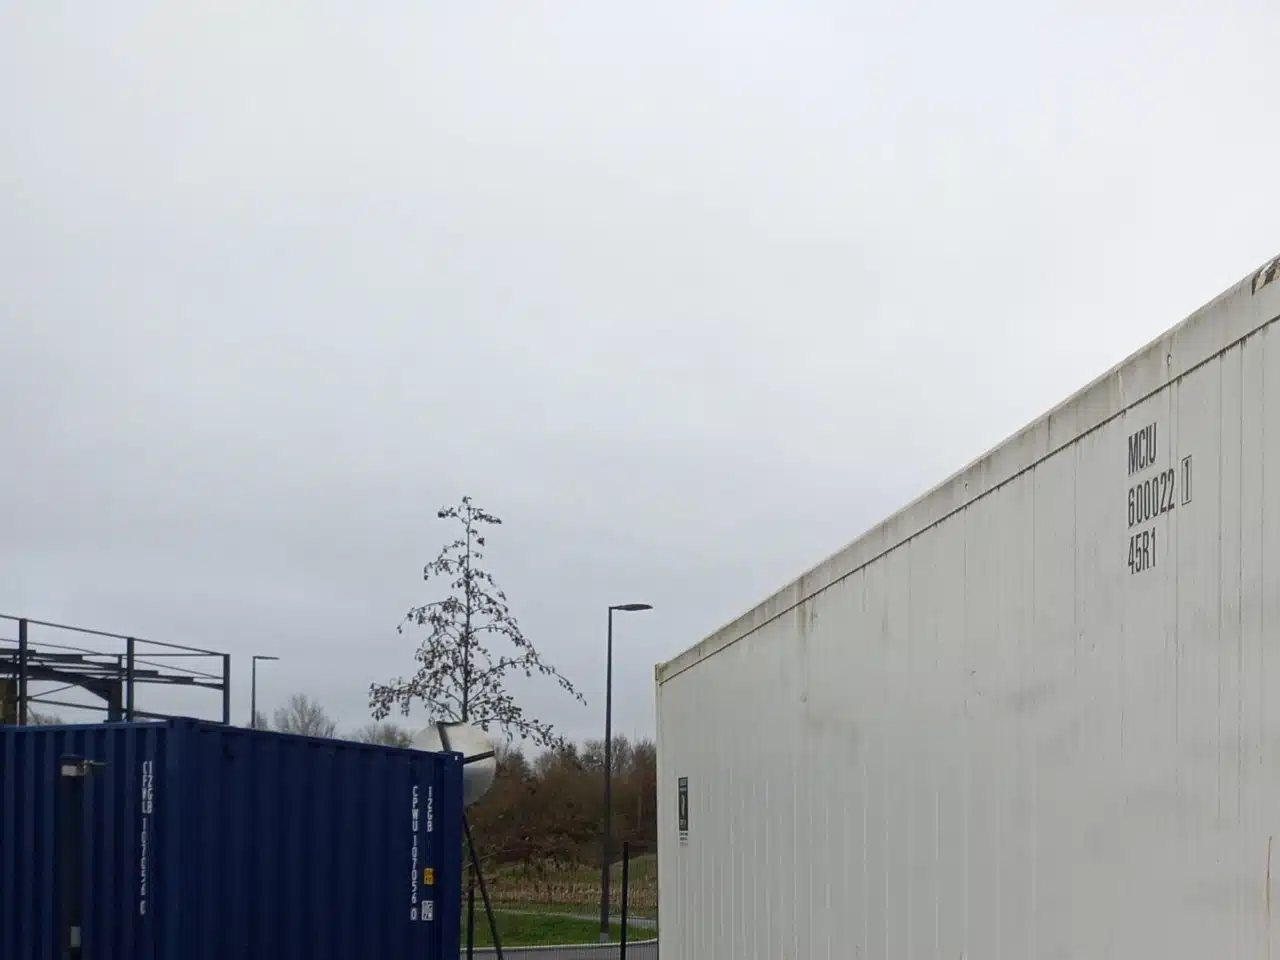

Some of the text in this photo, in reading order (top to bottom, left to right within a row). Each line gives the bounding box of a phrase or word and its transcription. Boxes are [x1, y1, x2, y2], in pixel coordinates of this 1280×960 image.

[1128, 422, 1157, 475] MCIU
[1128, 468, 1174, 528] 600022
[1128, 527, 1156, 574] 45R1
